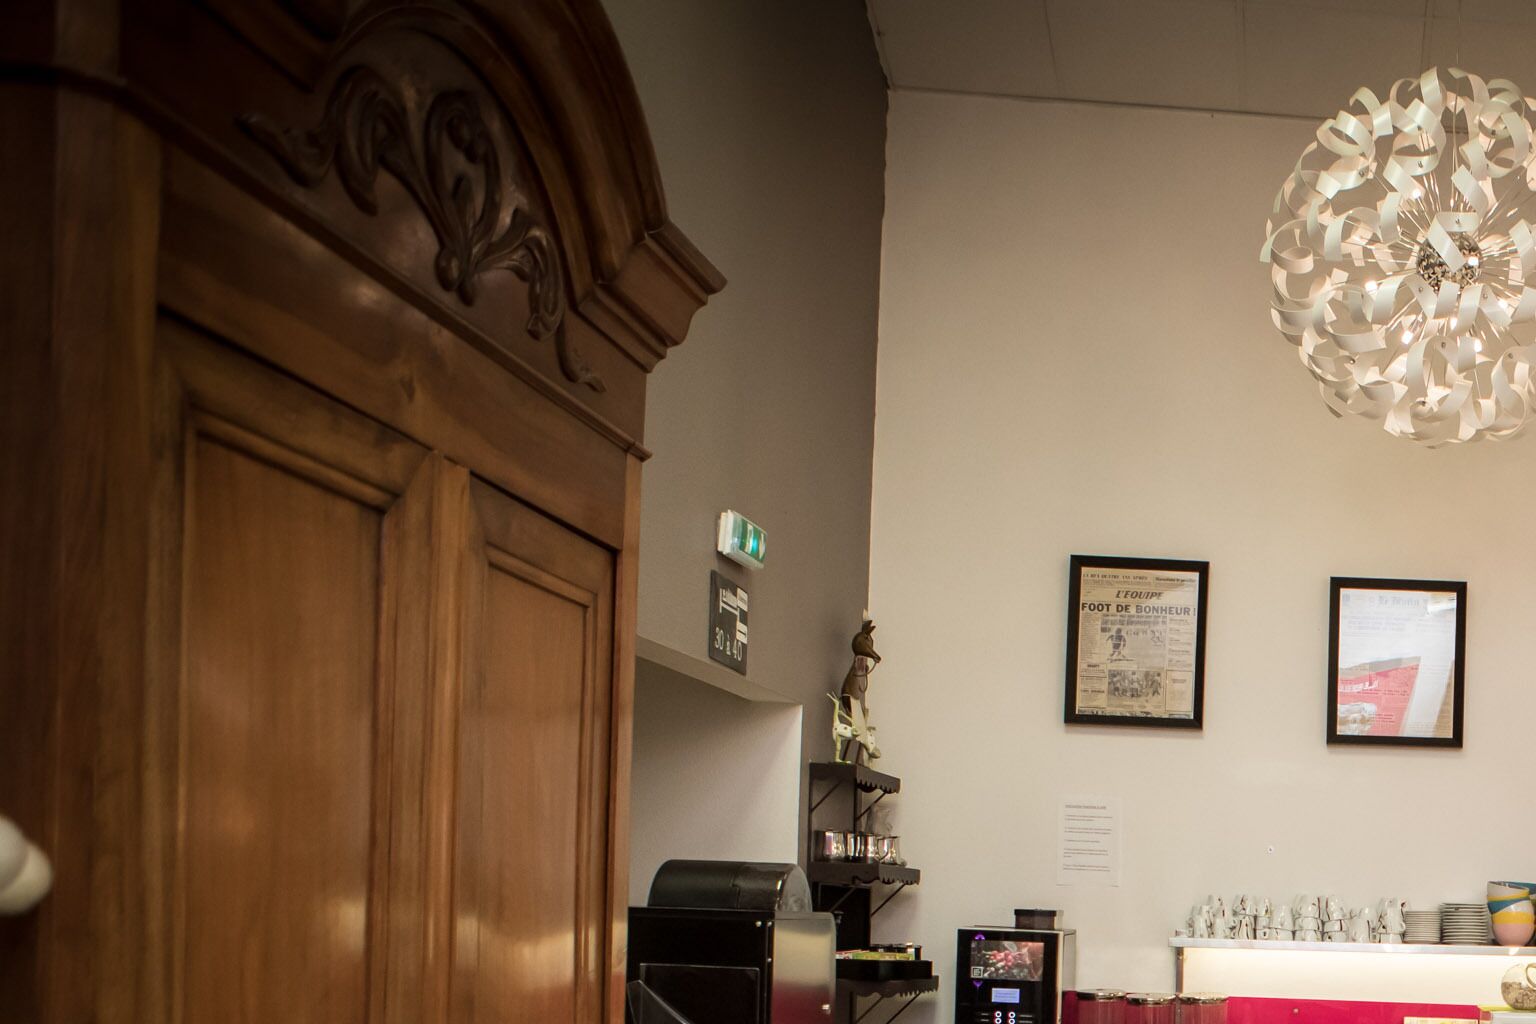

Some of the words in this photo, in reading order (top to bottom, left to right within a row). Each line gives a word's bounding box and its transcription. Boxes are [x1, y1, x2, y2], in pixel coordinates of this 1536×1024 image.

[1081, 602, 1112, 612] FOOT
[1116, 604, 1131, 613] DE
[1135, 604, 1191, 616] BONHEUR
[715, 627, 724, 650] 30
[733, 639, 742, 661] 40
